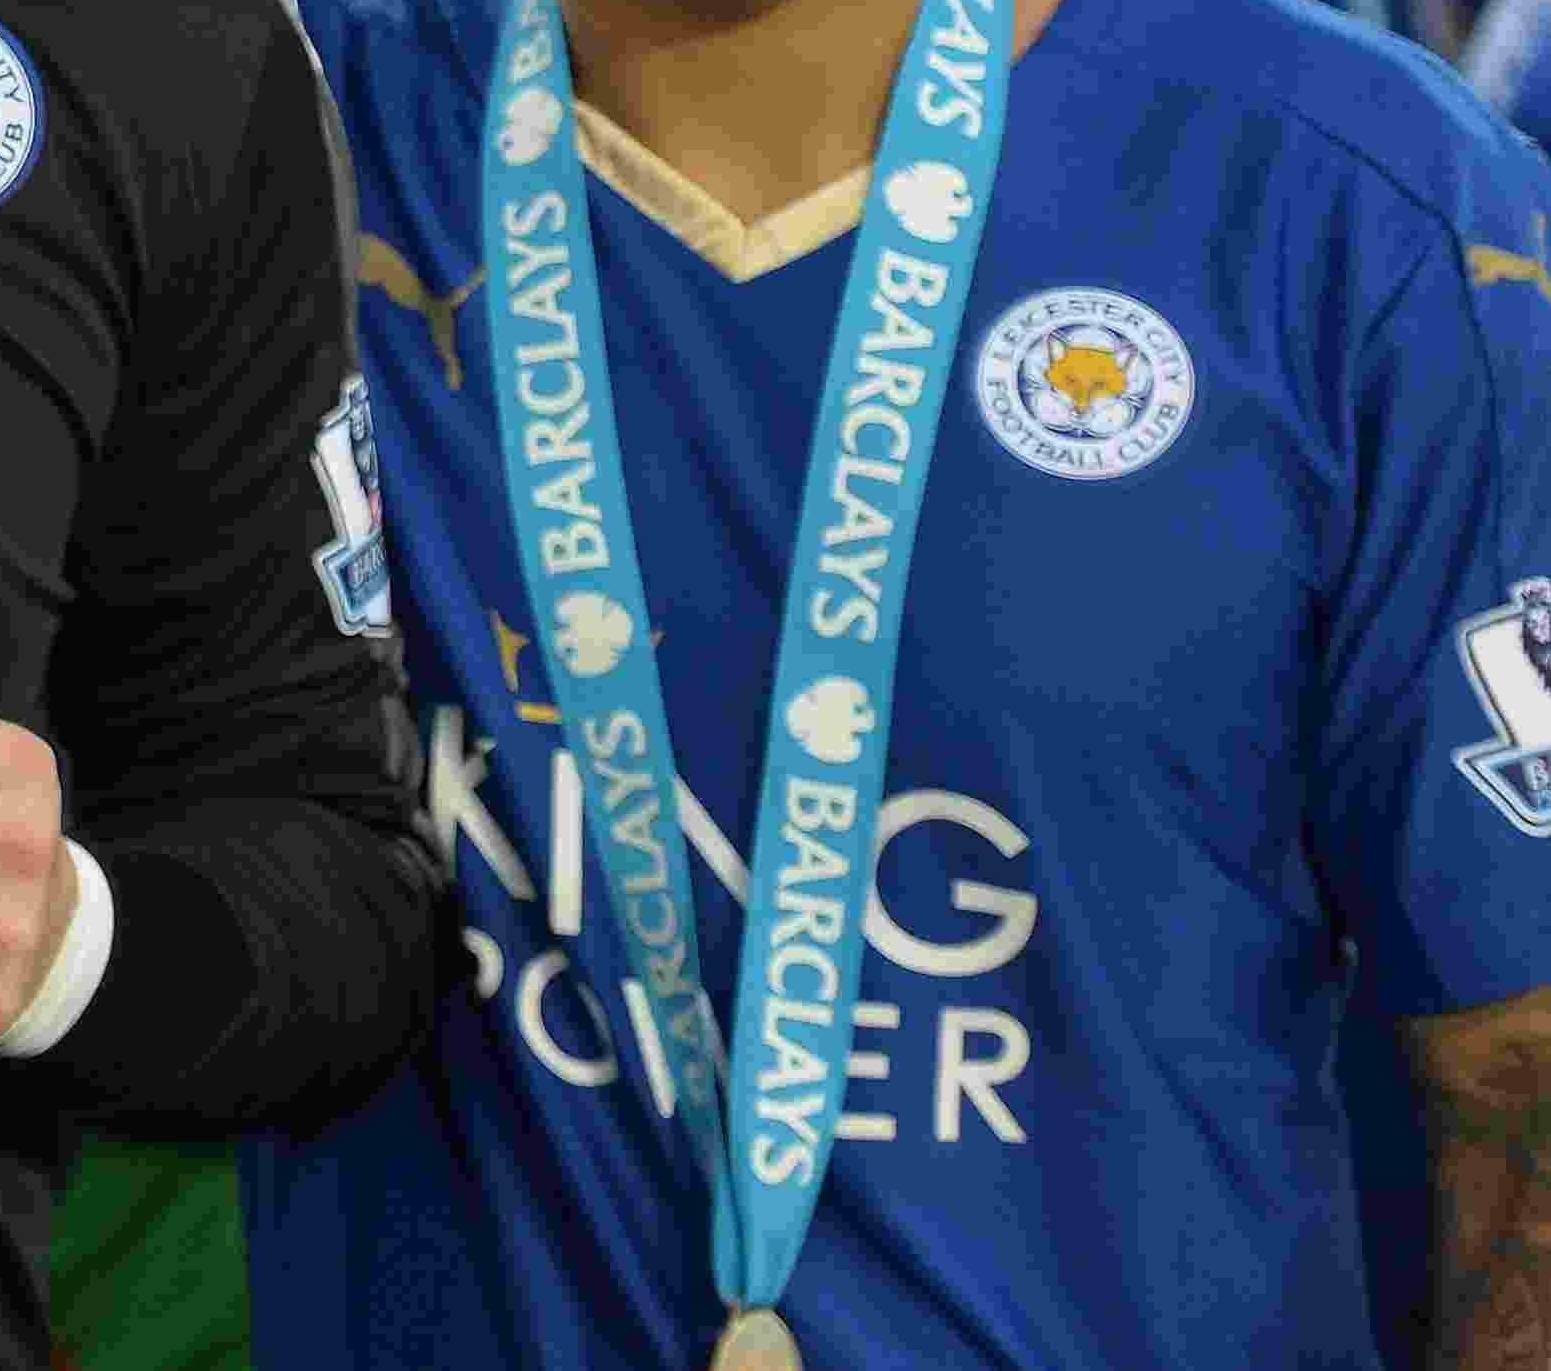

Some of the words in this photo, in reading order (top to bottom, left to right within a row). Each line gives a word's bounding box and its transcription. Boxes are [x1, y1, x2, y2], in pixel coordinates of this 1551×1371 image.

[507, 190, 611, 577] BARCLAYS
[809, 251, 948, 641] BARCLAYS
[748, 778, 854, 1188] BARCLAYS
